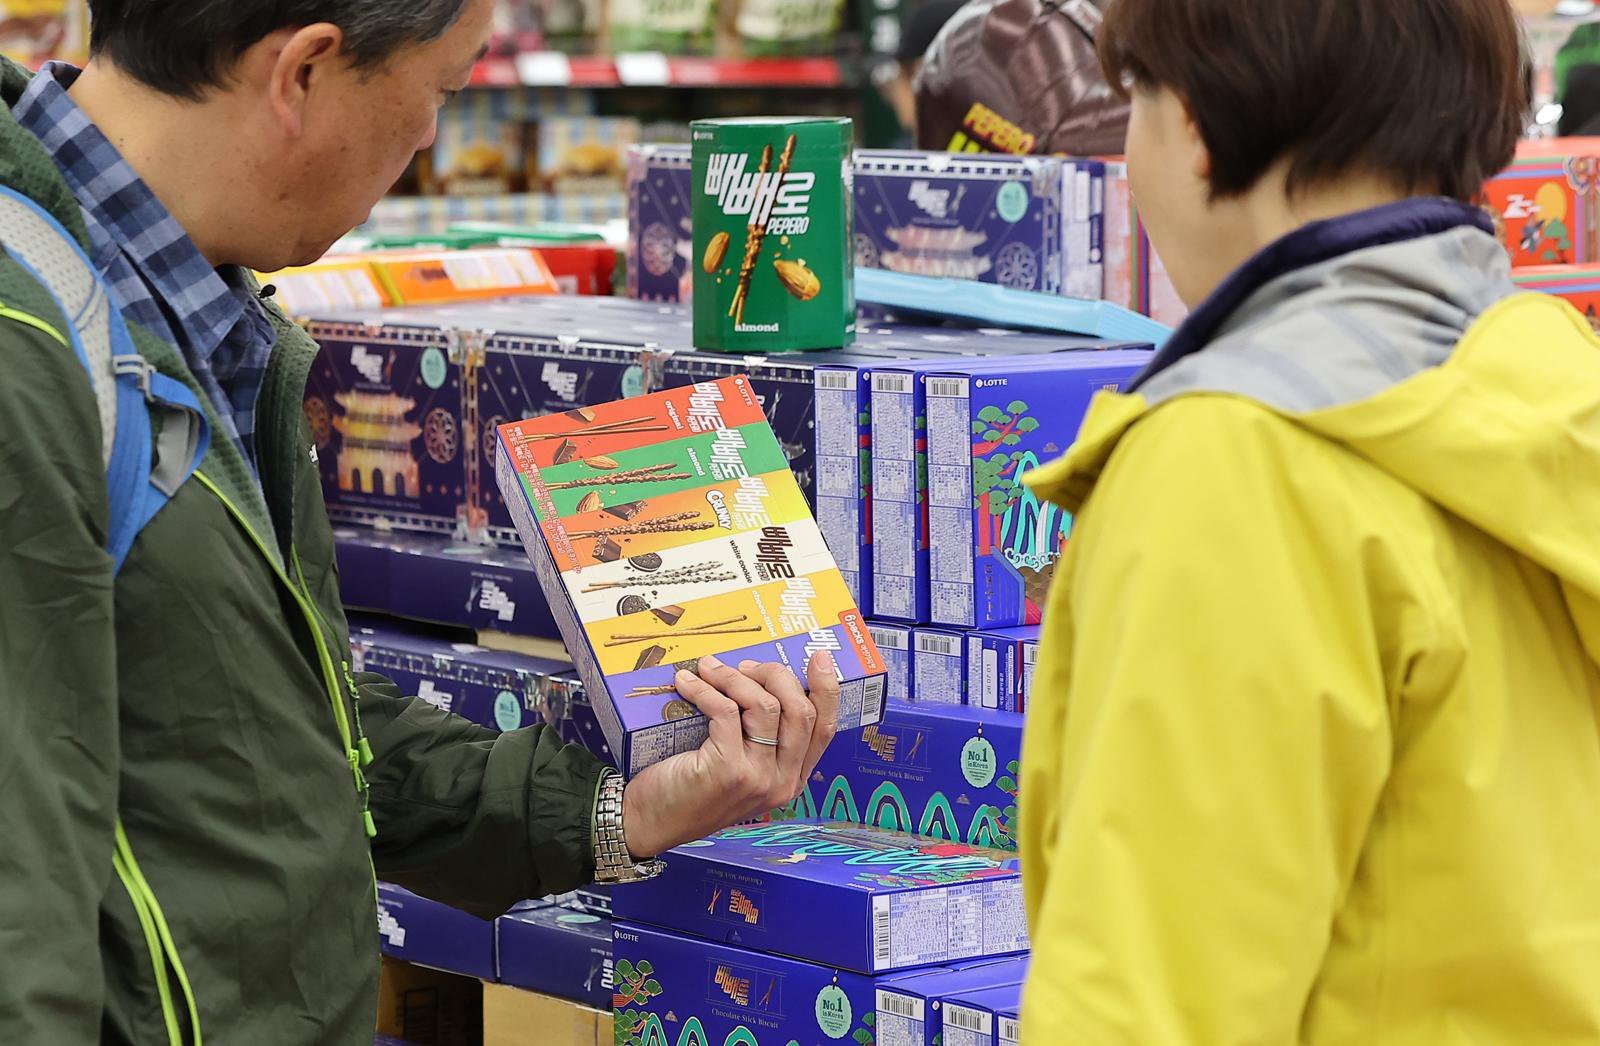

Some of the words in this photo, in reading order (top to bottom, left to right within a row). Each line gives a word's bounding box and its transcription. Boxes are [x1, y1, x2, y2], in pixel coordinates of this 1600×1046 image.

[964, 102, 1035, 154] PEPERO
[704, 153, 816, 225] 빼빼로
[766, 216, 809, 235] PEPERO
[735, 323, 779, 332] almond
[738, 384, 754, 407] LOTTE
[983, 378, 1008, 387] LOTTE
[665, 400, 684, 431] original
[688, 382, 727, 431] 빼빼로
[687, 447, 706, 477] almond
[710, 429, 751, 479] 빼빼로
[706, 490, 732, 530] CRUNKY
[733, 477, 772, 528] 빼빼로
[729, 539, 742, 561] white
[738, 560, 753, 584] cookie
[755, 526, 796, 579] 빼빼로
[778, 577, 820, 631] 빼빼로
[861, 725, 898, 756] 빼빼로
[967, 747, 988, 763] No.1
[729, 892, 759, 925] 빼빼로
[620, 930, 639, 942] LOTTE
[711, 1007, 742, 1021] Chocolate
[742, 1015, 757, 1025] Stick
[758, 1017, 779, 1029] Biscuit
[822, 998, 843, 1013] No.1
